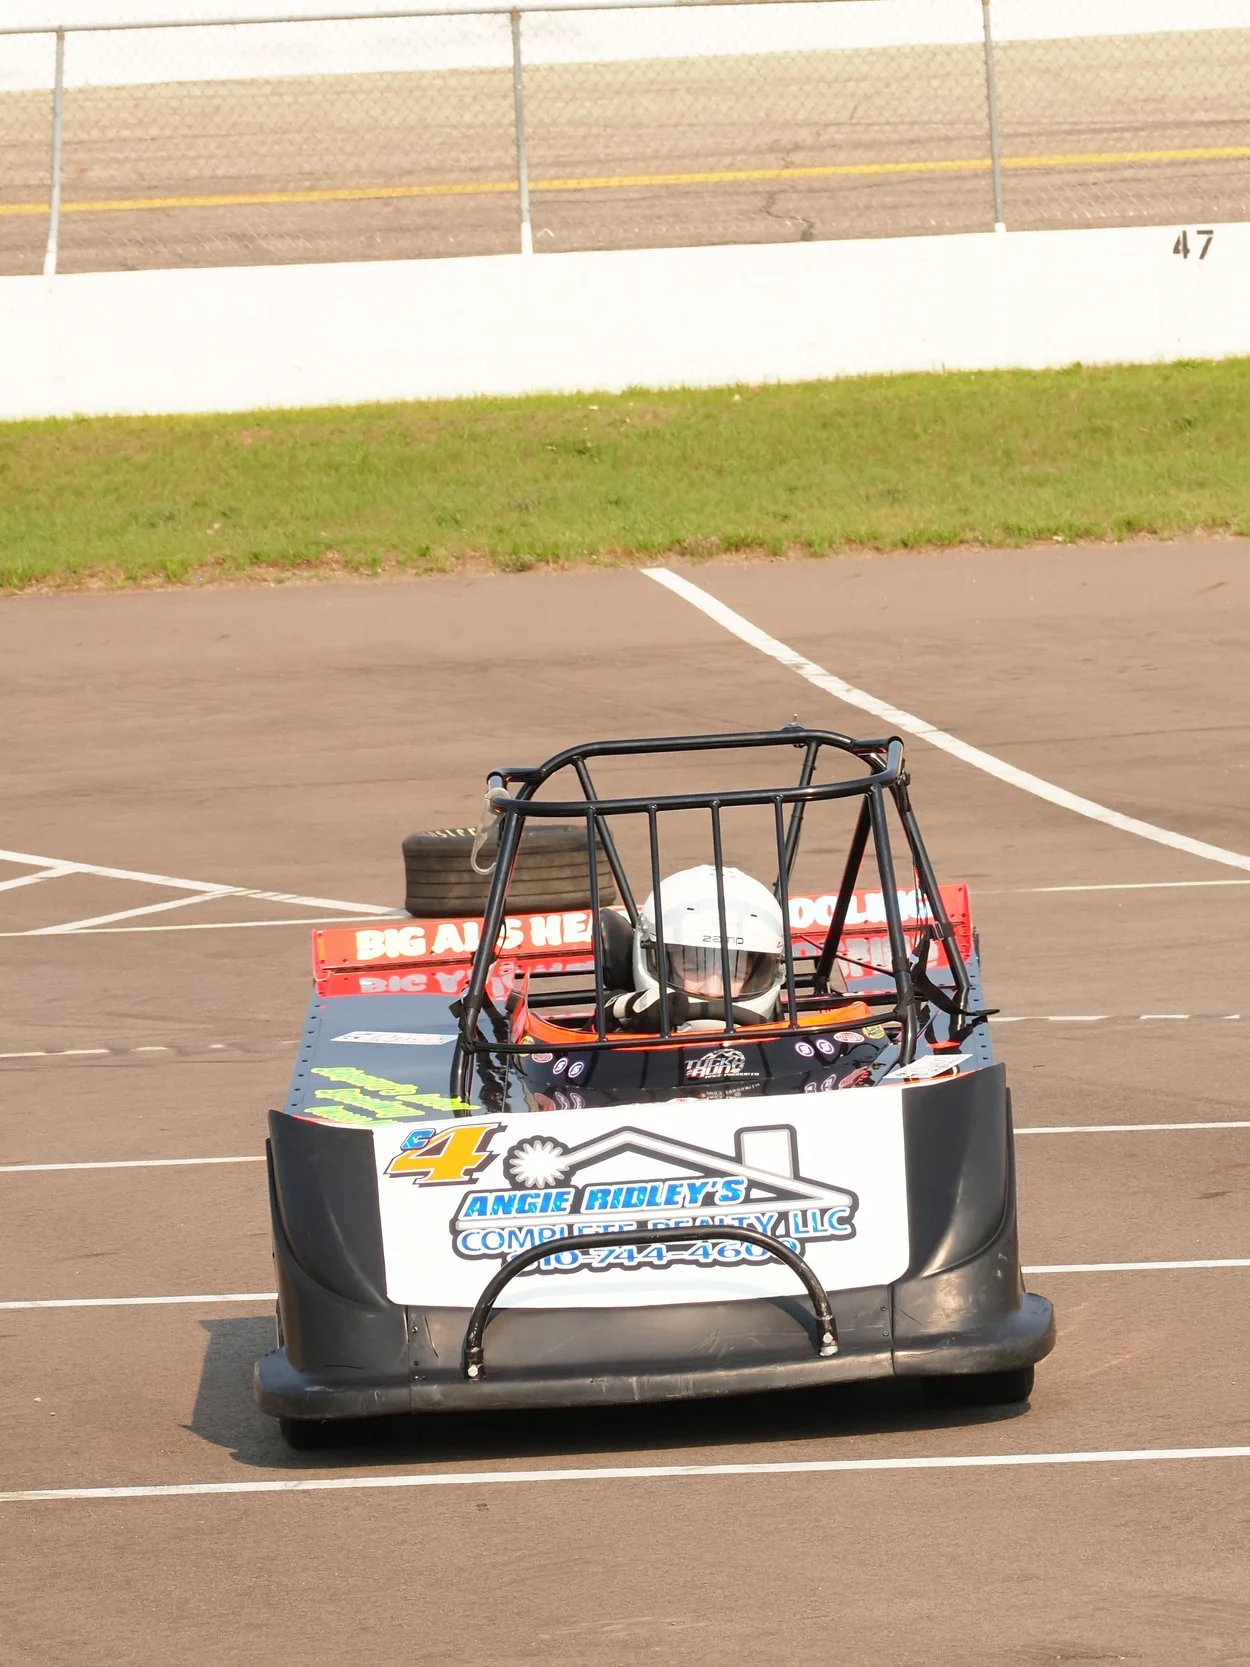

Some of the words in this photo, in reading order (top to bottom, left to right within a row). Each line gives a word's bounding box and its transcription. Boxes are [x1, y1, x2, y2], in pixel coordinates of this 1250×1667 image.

[1172, 229, 1214, 260] 47
[354, 926, 426, 960] BIG
[463, 1190, 572, 1217] ANGIE
[585, 1178, 745, 1211] RIDLEY'S
[793, 1208, 850, 1235] LLC
